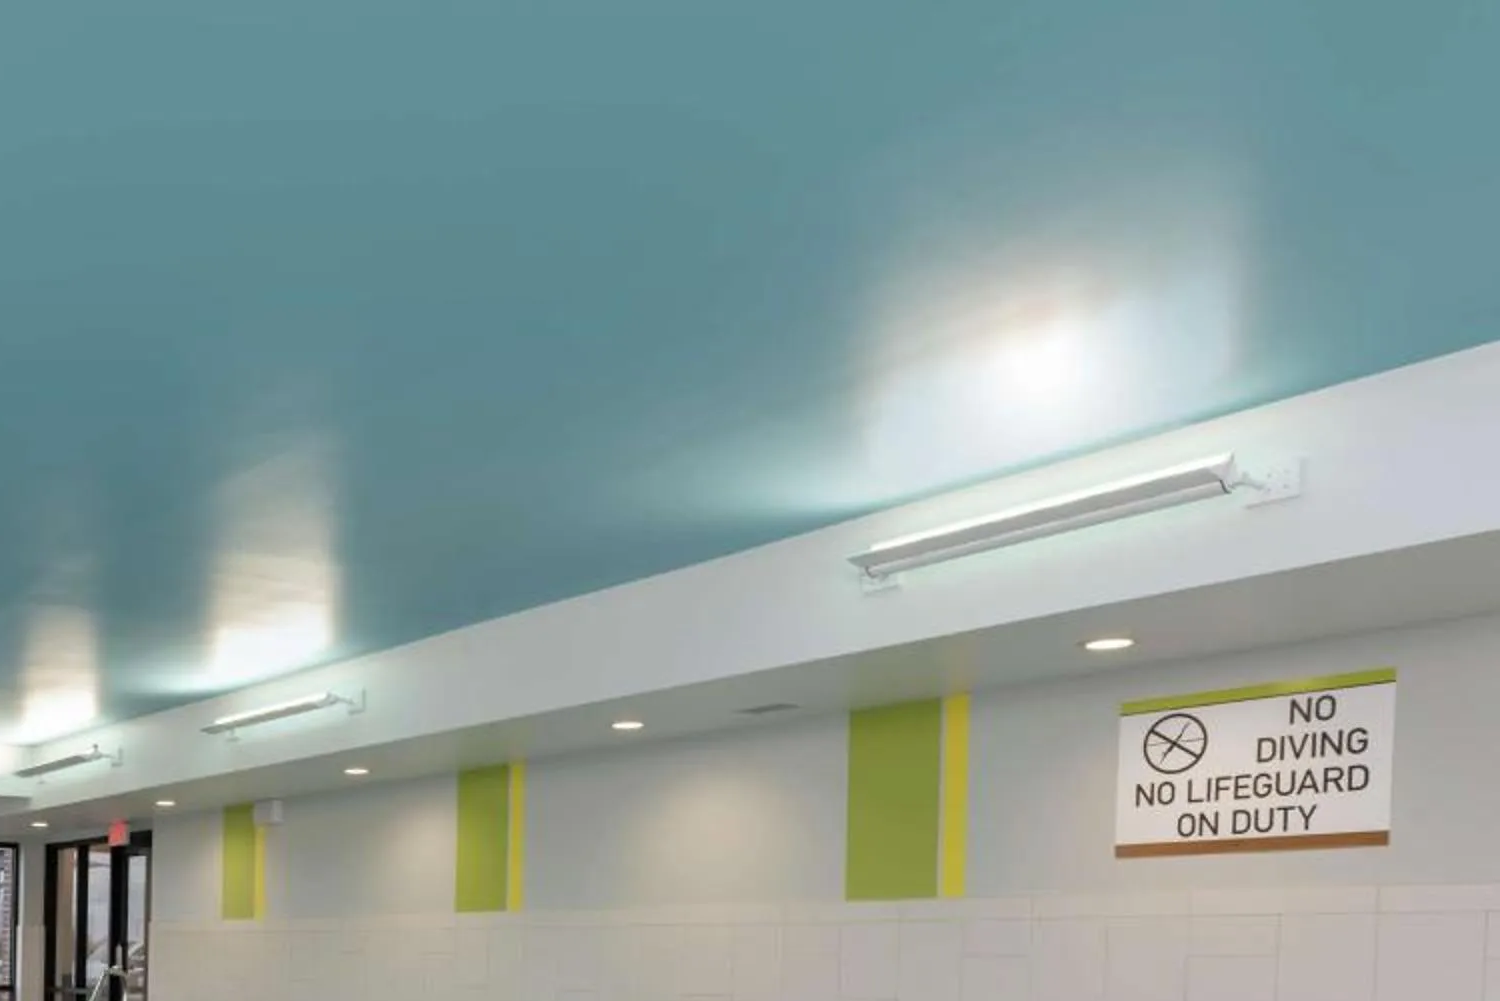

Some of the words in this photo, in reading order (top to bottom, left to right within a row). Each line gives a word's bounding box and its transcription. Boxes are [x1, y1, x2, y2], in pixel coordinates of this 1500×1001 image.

[1289, 694, 1337, 725] NO
[1256, 727, 1369, 764] DIVING
[1135, 780, 1176, 808] NO
[1187, 764, 1370, 804] LIFEGUARD
[1176, 810, 1219, 837] ON
[1231, 803, 1318, 836] DUTY
